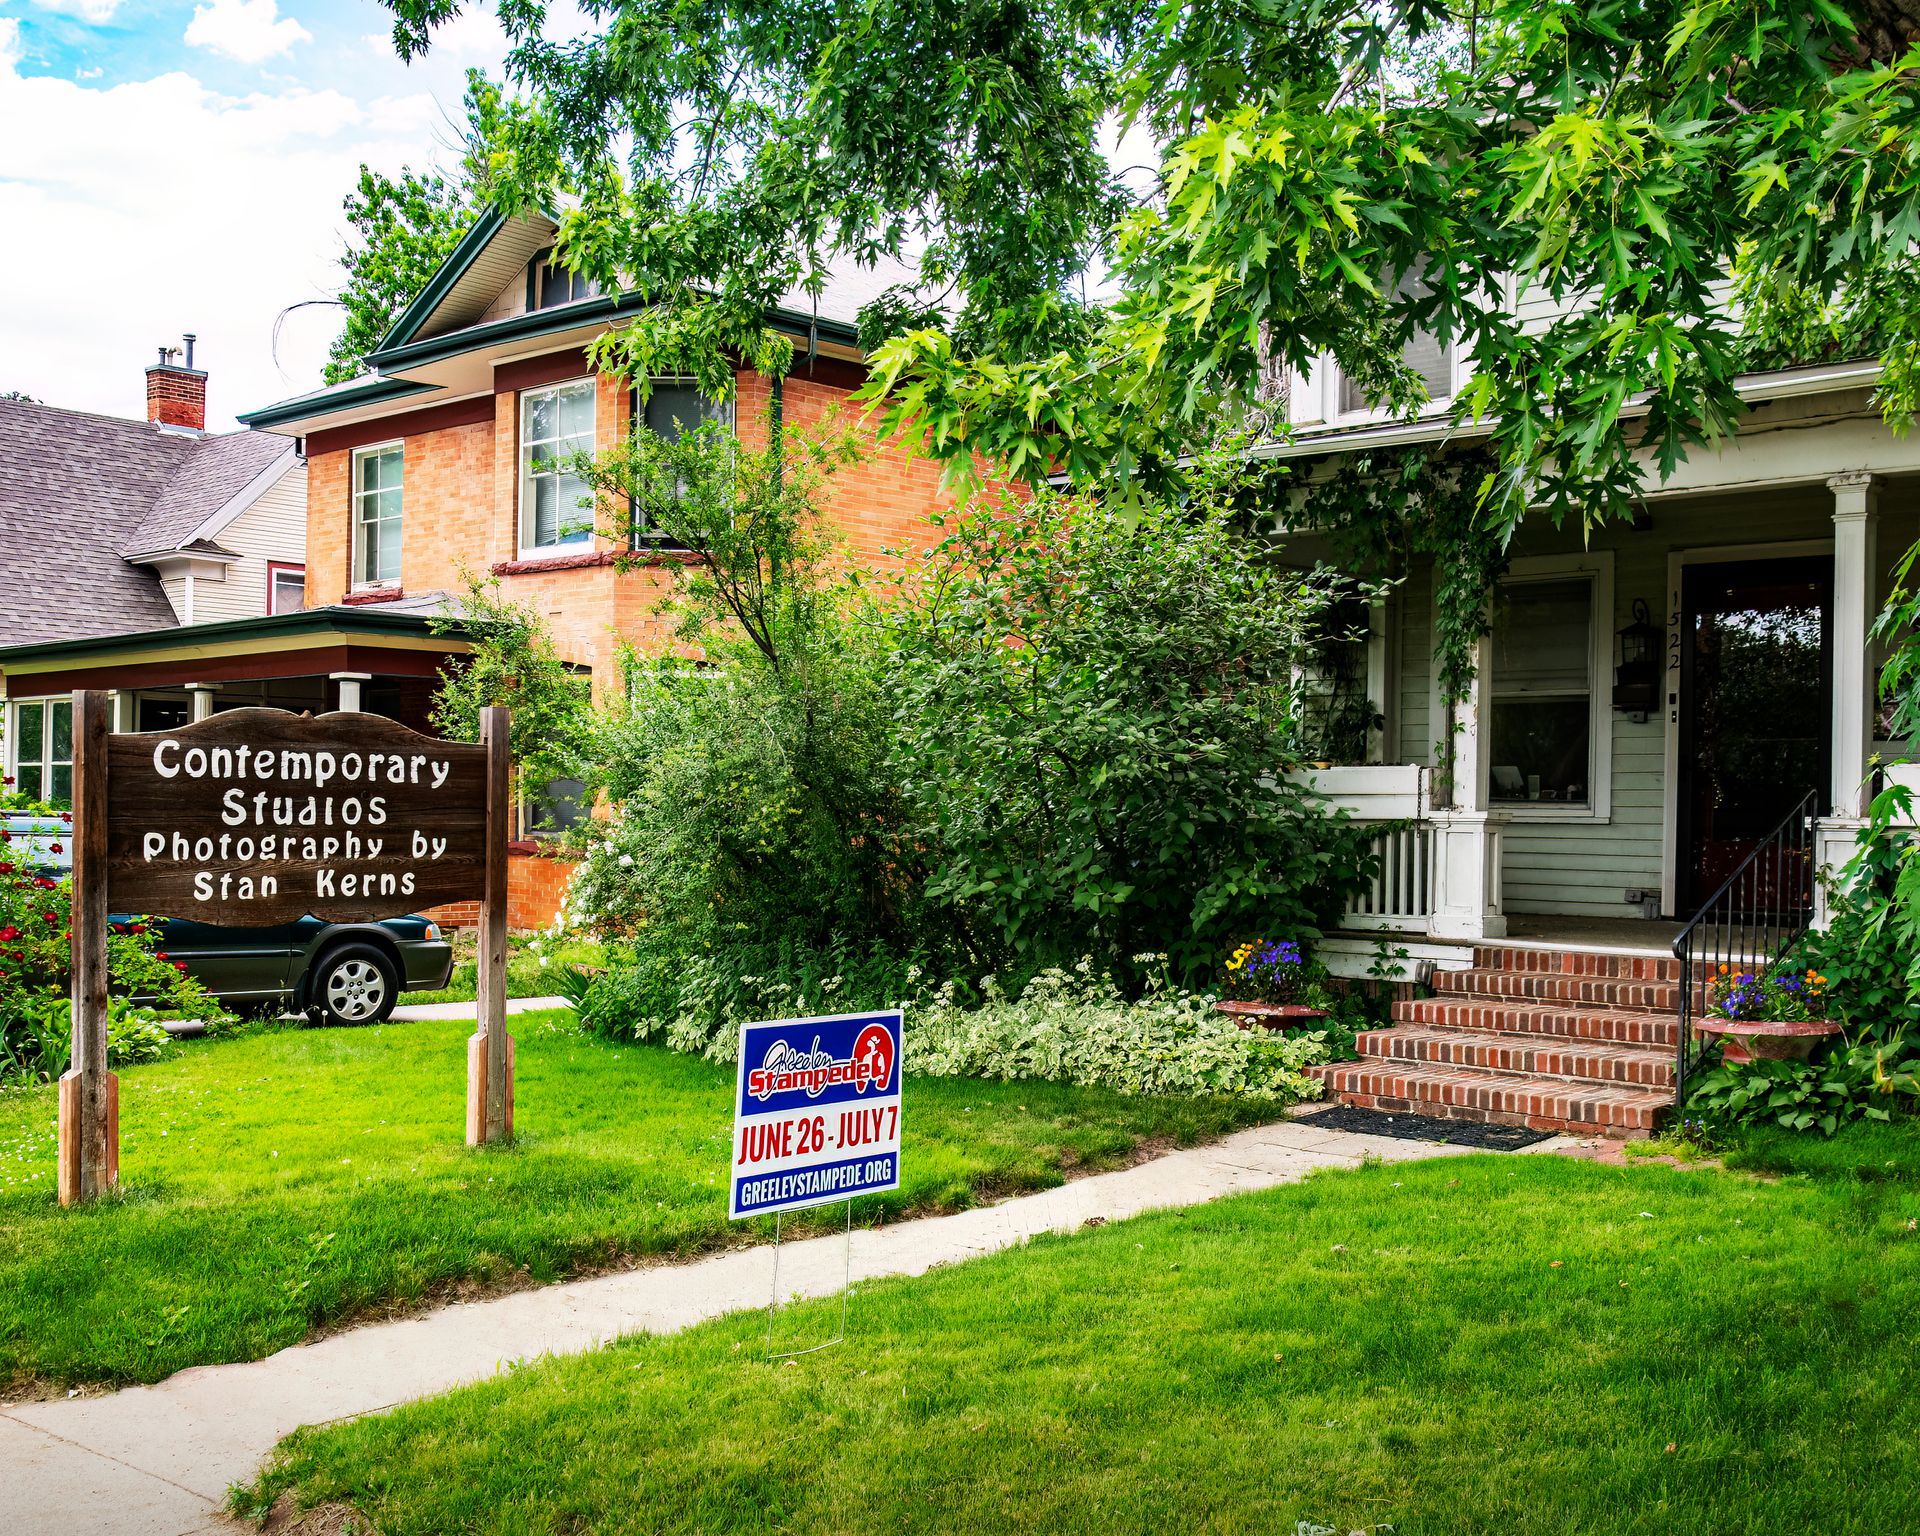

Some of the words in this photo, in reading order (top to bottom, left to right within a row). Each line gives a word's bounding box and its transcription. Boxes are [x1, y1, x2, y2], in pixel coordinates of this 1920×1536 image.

[1667, 590, 1681, 670] 1522
[153, 739, 450, 789] Contemporary
[222, 788, 387, 826] Studios
[143, 830, 383, 863] Photography
[412, 830, 447, 860] by
[193, 871, 278, 901] Stan
[316, 869, 416, 898] Kerns
[749, 1059, 870, 1094] Stampede
[760, 1035, 833, 1100] Greeley
[738, 1120, 794, 1165] JUNE
[796, 1116, 825, 1155] 26
[836, 1107, 884, 1149] JULY
[888, 1106, 898, 1140] 7
[741, 1159, 891, 1207] GREELEYSTAMPEDE.ORG
